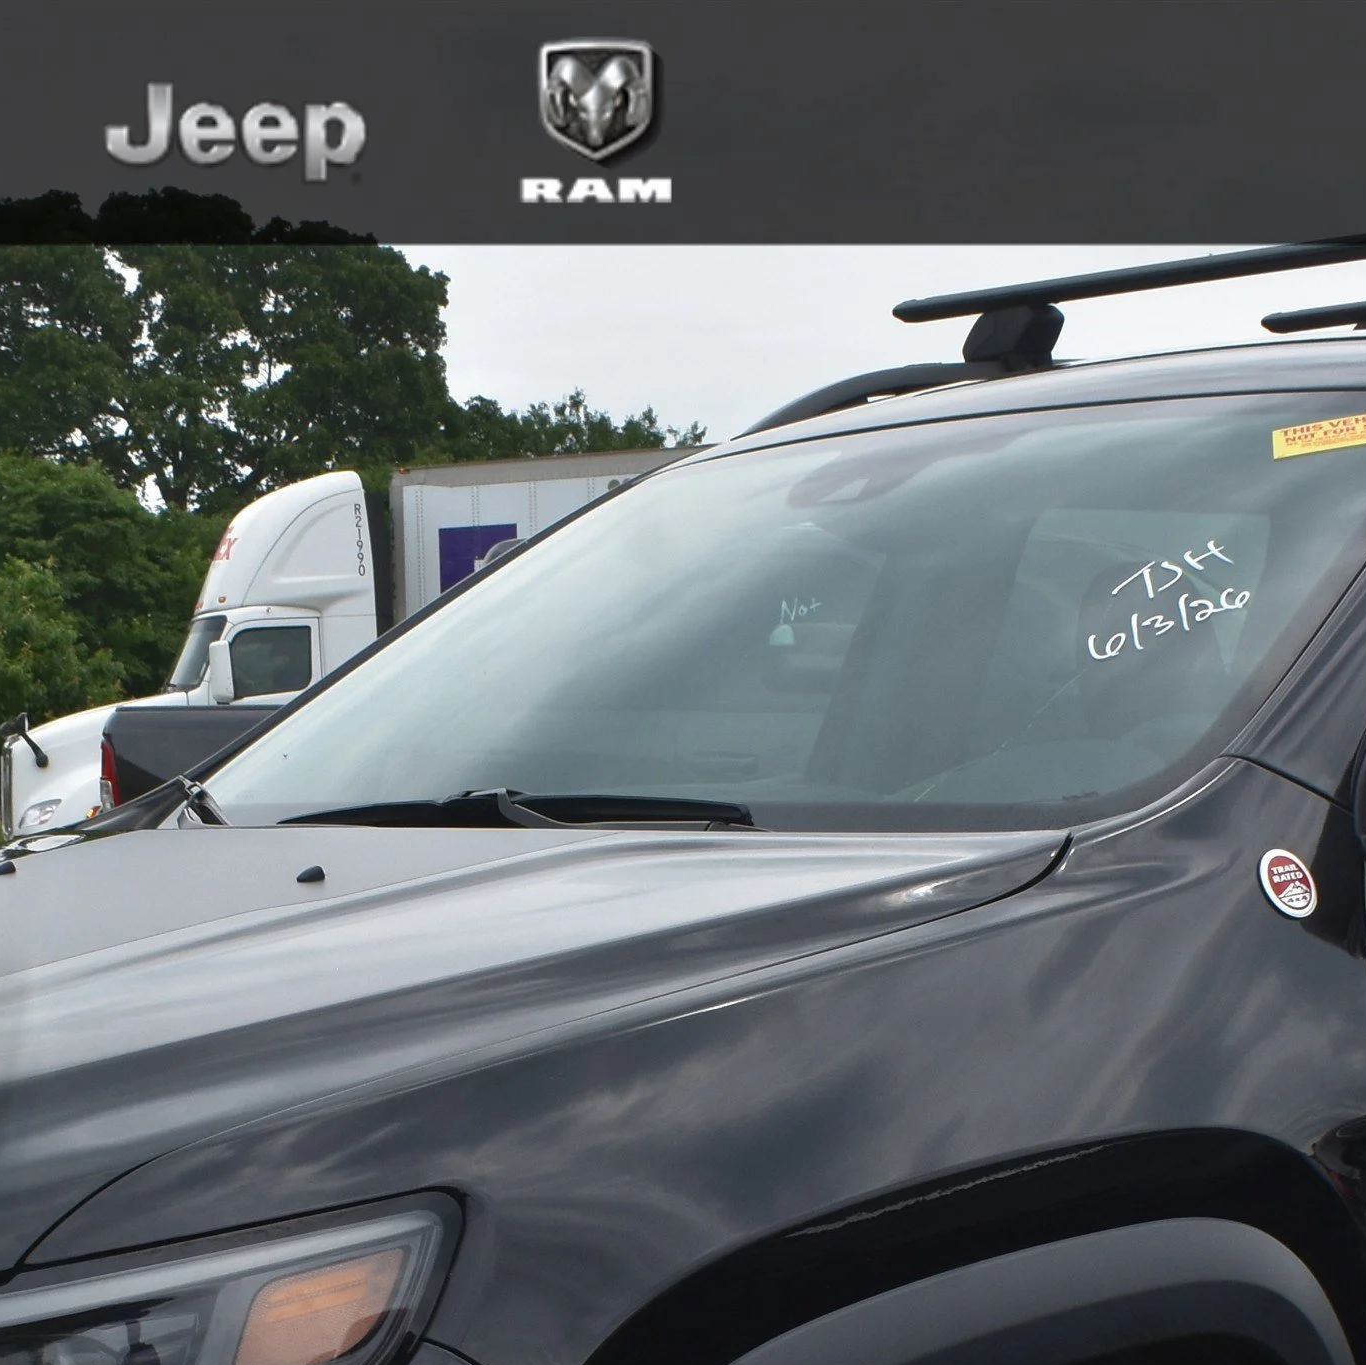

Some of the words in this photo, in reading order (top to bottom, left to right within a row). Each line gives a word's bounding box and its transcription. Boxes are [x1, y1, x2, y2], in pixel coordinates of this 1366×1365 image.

[1282, 423, 1324, 437] THIS
[1285, 432, 1316, 444] NOT
[1323, 426, 1356, 437] FOR
[353, 503, 366, 577] R21990
[1088, 587, 1251, 661] 6/3/26
[1271, 863, 1300, 875] TRAIL
[1272, 871, 1303, 884] RATED
